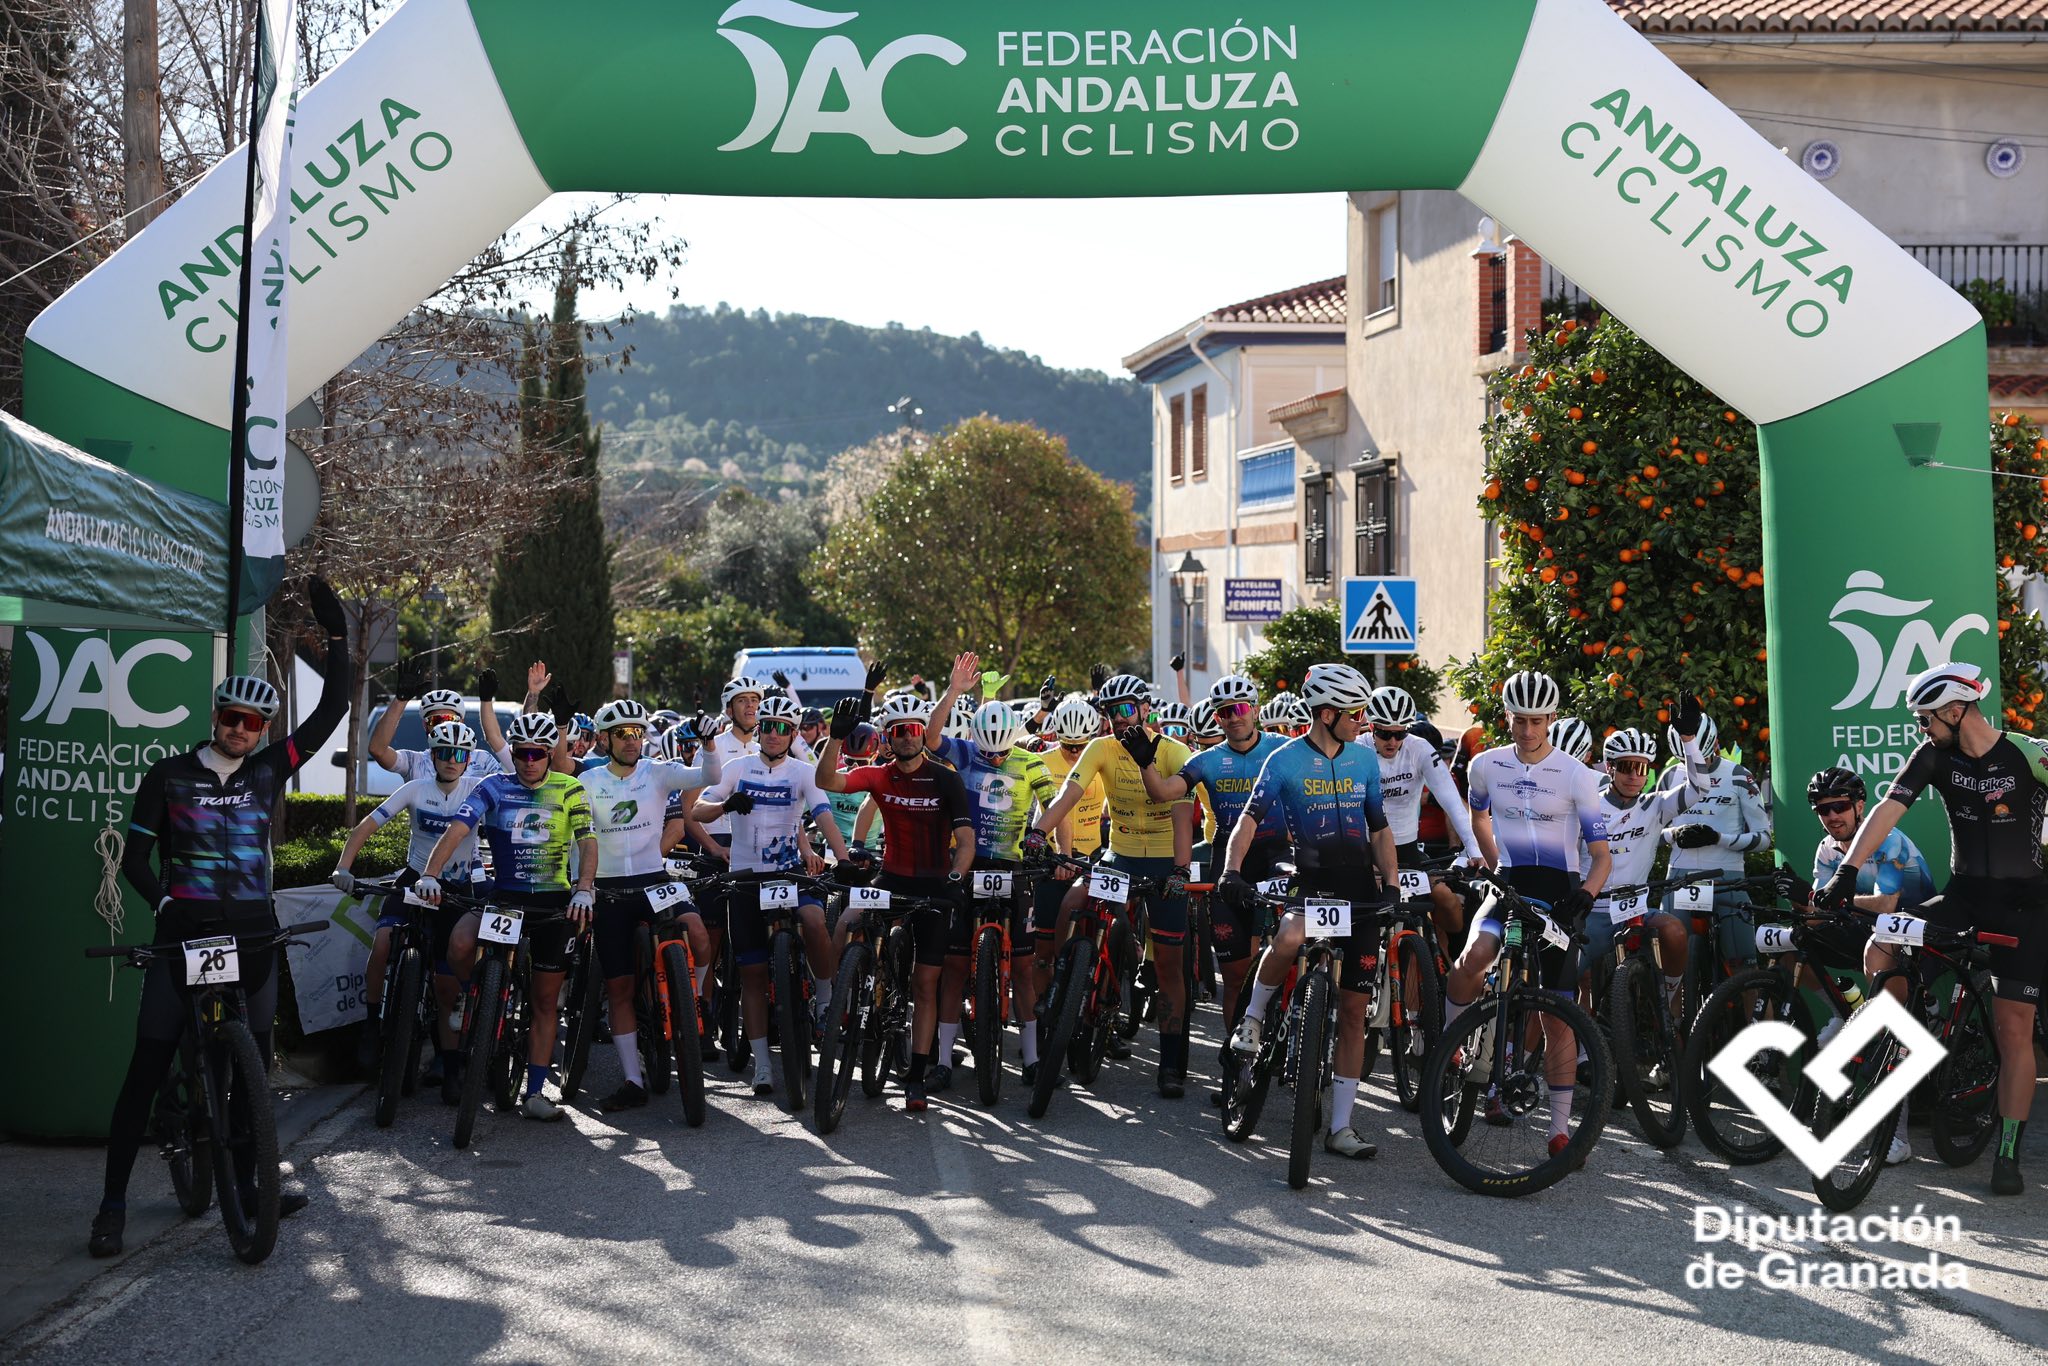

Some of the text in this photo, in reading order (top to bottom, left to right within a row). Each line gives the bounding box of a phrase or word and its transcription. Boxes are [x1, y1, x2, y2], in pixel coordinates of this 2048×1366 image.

[998, 18, 1298, 67] FEDERACIÓN
[997, 71, 1300, 115] ANDALUZA
[995, 118, 1300, 157] CICLISMO
[1590, 88, 1854, 305] ANDALUZA
[157, 98, 421, 320] ANDLUZA
[1561, 121, 1829, 338] CICLISMO
[186, 131, 453, 353] CILISMO
[1230, 581, 1277, 589] PASTELERIA
[1226, 600, 1281, 611] JENNIFER
[17, 766, 147, 795] ANDALU
[1304, 777, 1353, 796] SEMAR
[1952, 771, 2015, 793] Bull Bikes
[745, 789, 787, 798] TREK
[882, 793, 940, 807] TREK
[15, 794, 124, 823] CICLIS
[980, 813, 1010, 822] IVECO
[1100, 875, 1120, 893] 36
[1400, 873, 1419, 889] 45
[656, 884, 677, 900] 96
[770, 886, 789, 900] 73
[1690, 886, 1700, 901] 9
[490, 916, 512, 936] 42
[1317, 907, 1340, 926] 30
[1887, 916, 1914, 934] 37
[1763, 929, 1782, 946] 81
